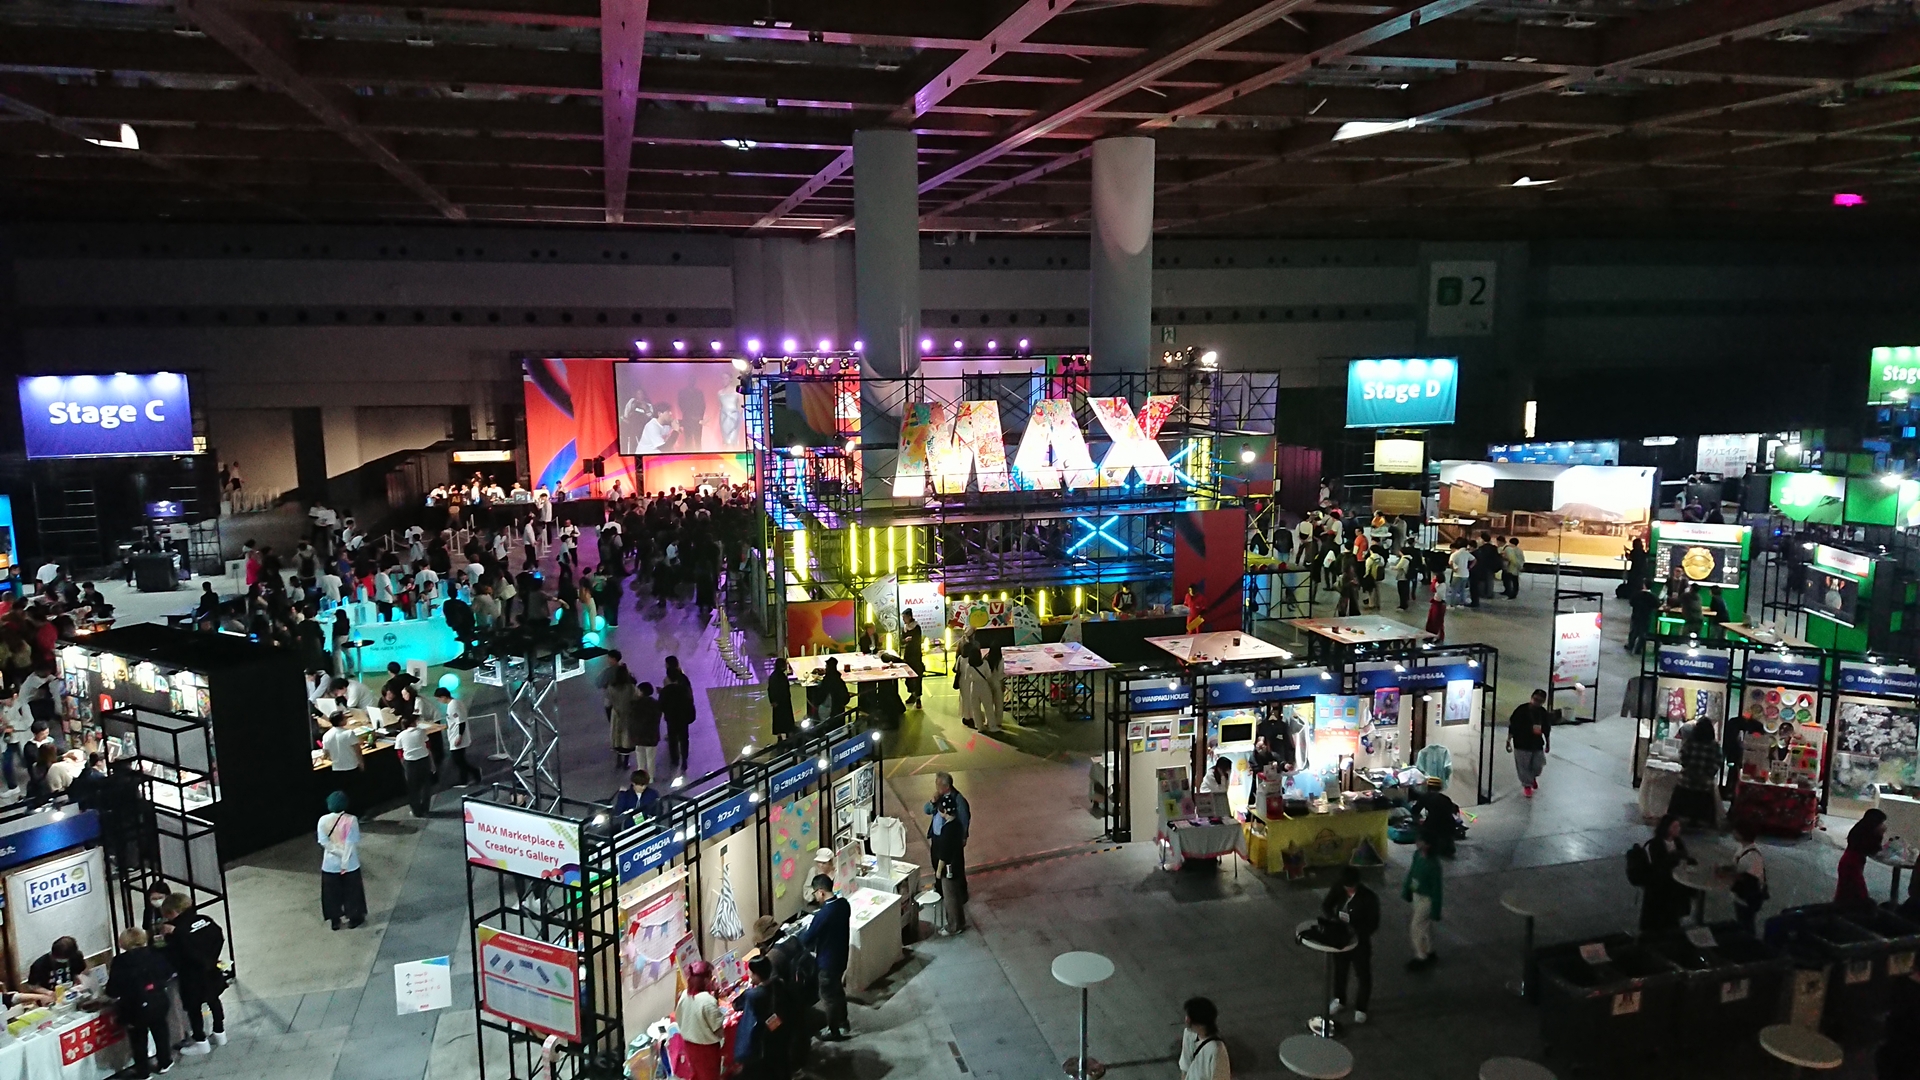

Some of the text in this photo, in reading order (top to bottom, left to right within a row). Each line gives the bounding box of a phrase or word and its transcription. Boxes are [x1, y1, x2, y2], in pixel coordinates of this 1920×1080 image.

[1469, 277, 1486, 304] 2
[1363, 379, 1440, 403] Stage D
[48, 399, 165, 429] Stage C
[892, 394, 1180, 497] MAX
[1561, 632, 1581, 640] MAX
[1857, 676, 1883, 685] Noriko
[1141, 692, 1190, 703] WANPAKU HOUSE
[839, 741, 866, 760] MELT HOUSE
[477, 822, 565, 850] MAX Marketplace &
[484, 839, 560, 867] Creator's Gallery
[632, 836, 671, 862] CHACHACHA
[642, 850, 663, 867] TIMES
[29, 872, 68, 895] Font
[31, 880, 87, 909] Karuta
